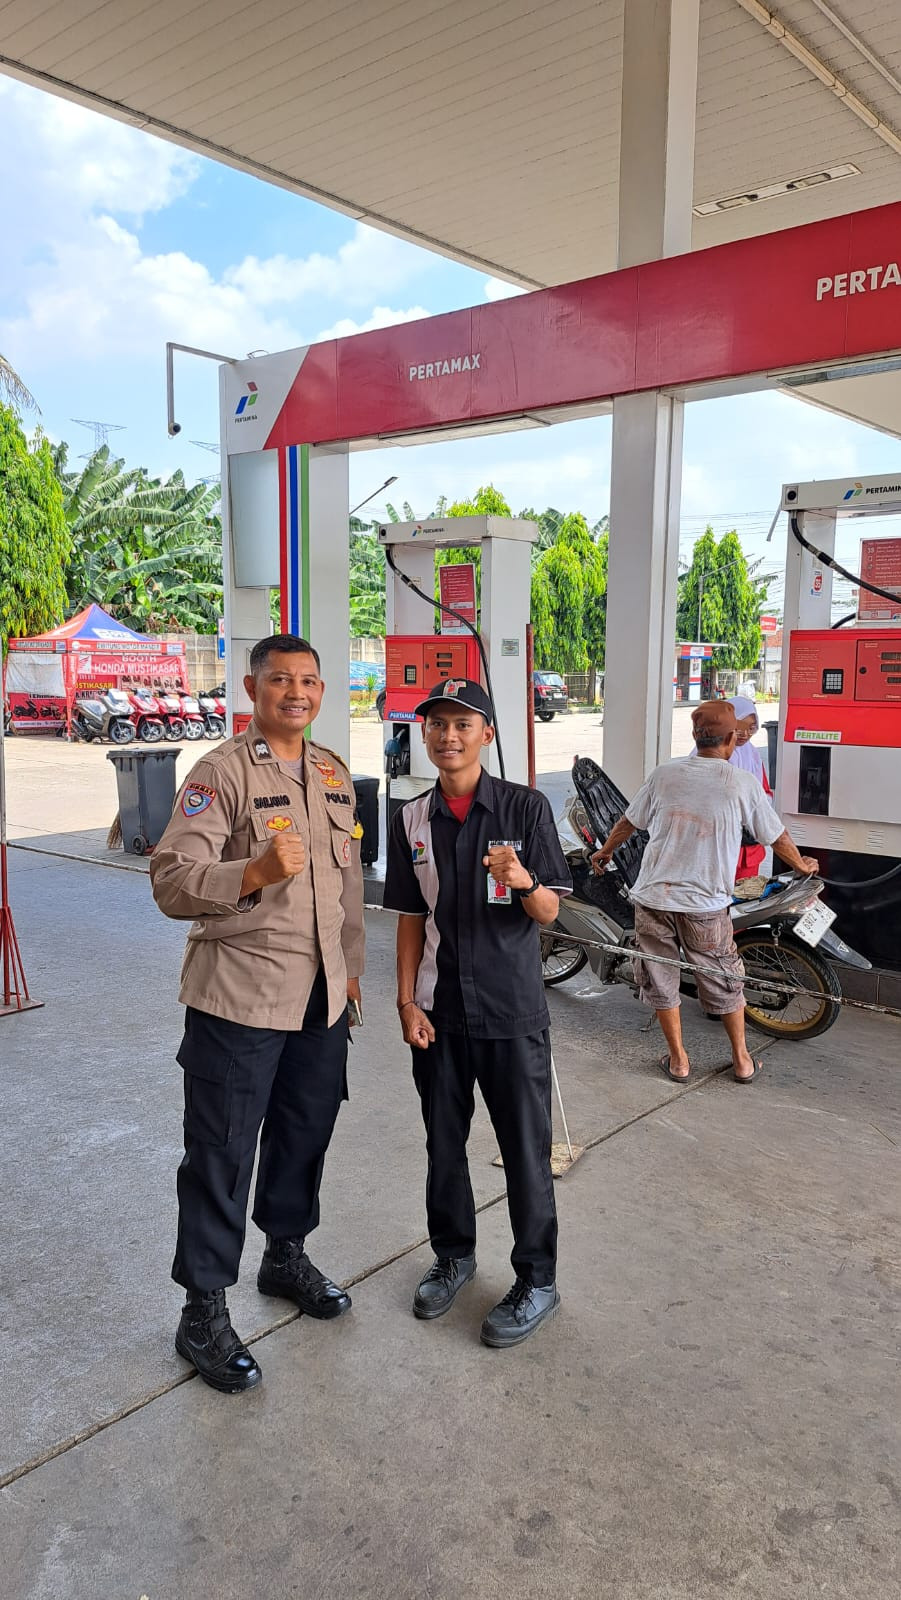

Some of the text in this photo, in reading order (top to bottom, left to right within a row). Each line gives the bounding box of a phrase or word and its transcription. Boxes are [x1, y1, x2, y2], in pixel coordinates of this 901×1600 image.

[816, 262, 901, 301] PERTA
[409, 353, 481, 381] PERTAMAX
[94, 663, 125, 673] HONDA
[796, 731, 839, 740] PERTALITE
[324, 792, 351, 805] POLRI
